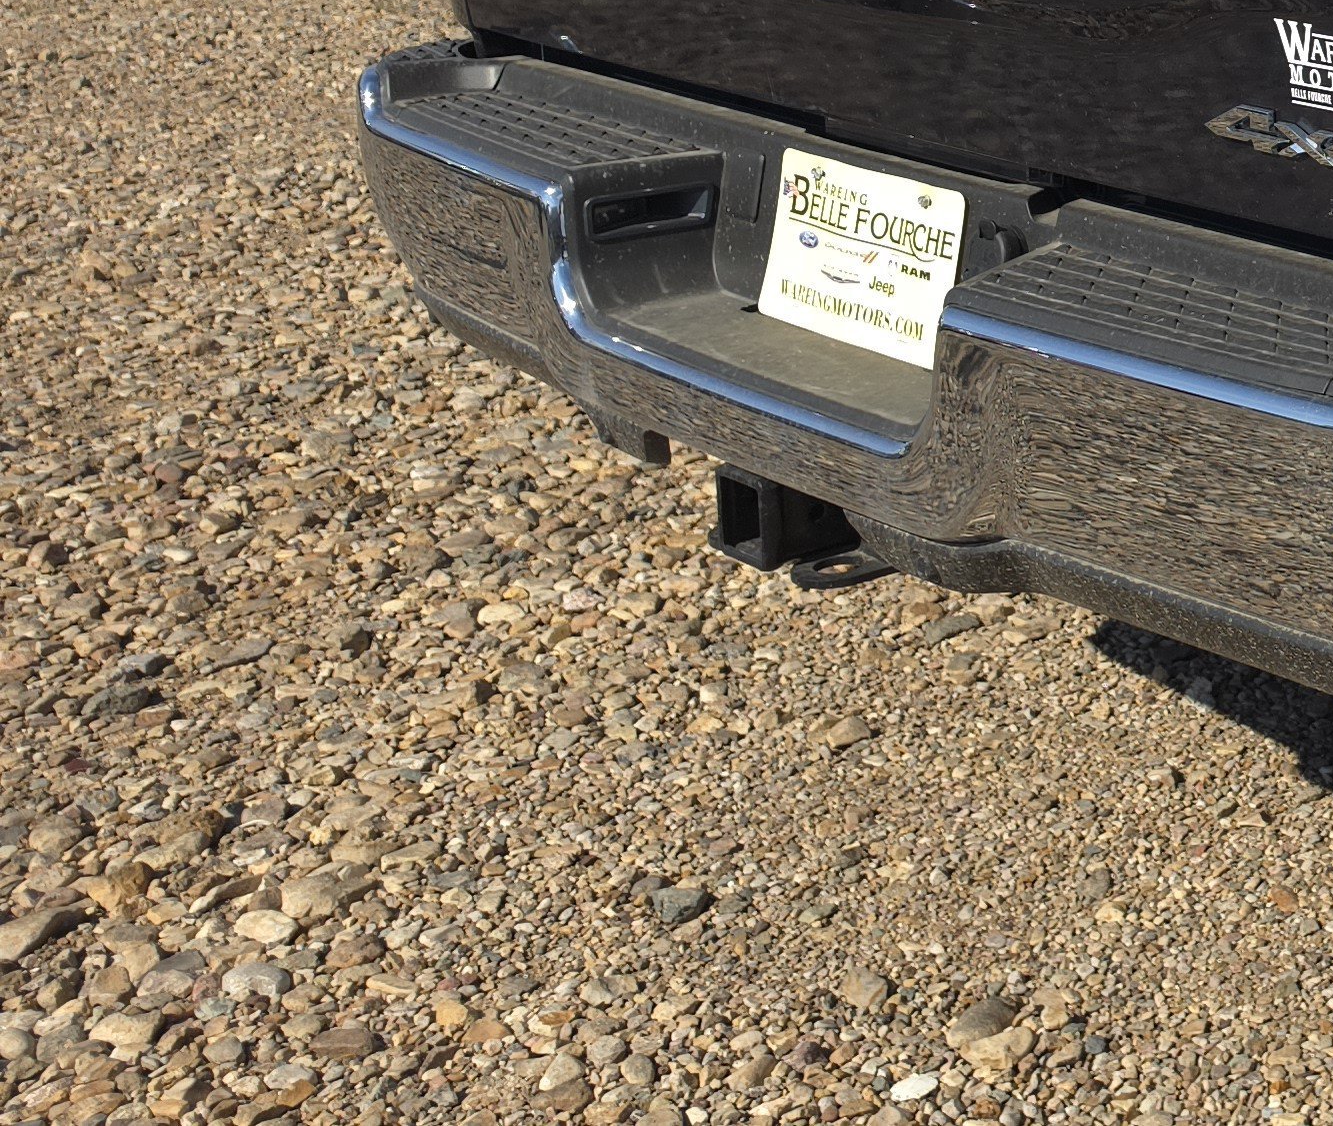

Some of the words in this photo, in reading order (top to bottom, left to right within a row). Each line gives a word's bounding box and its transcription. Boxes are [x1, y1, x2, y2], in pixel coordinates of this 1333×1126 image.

[814, 178, 868, 206] WAREING
[790, 174, 850, 231] BELLE
[854, 207, 956, 262] FOURCHE
[868, 275, 895, 297] Jeep
[901, 263, 931, 281] RAM
[781, 278, 924, 341] WAREINGMOTORS.COM
